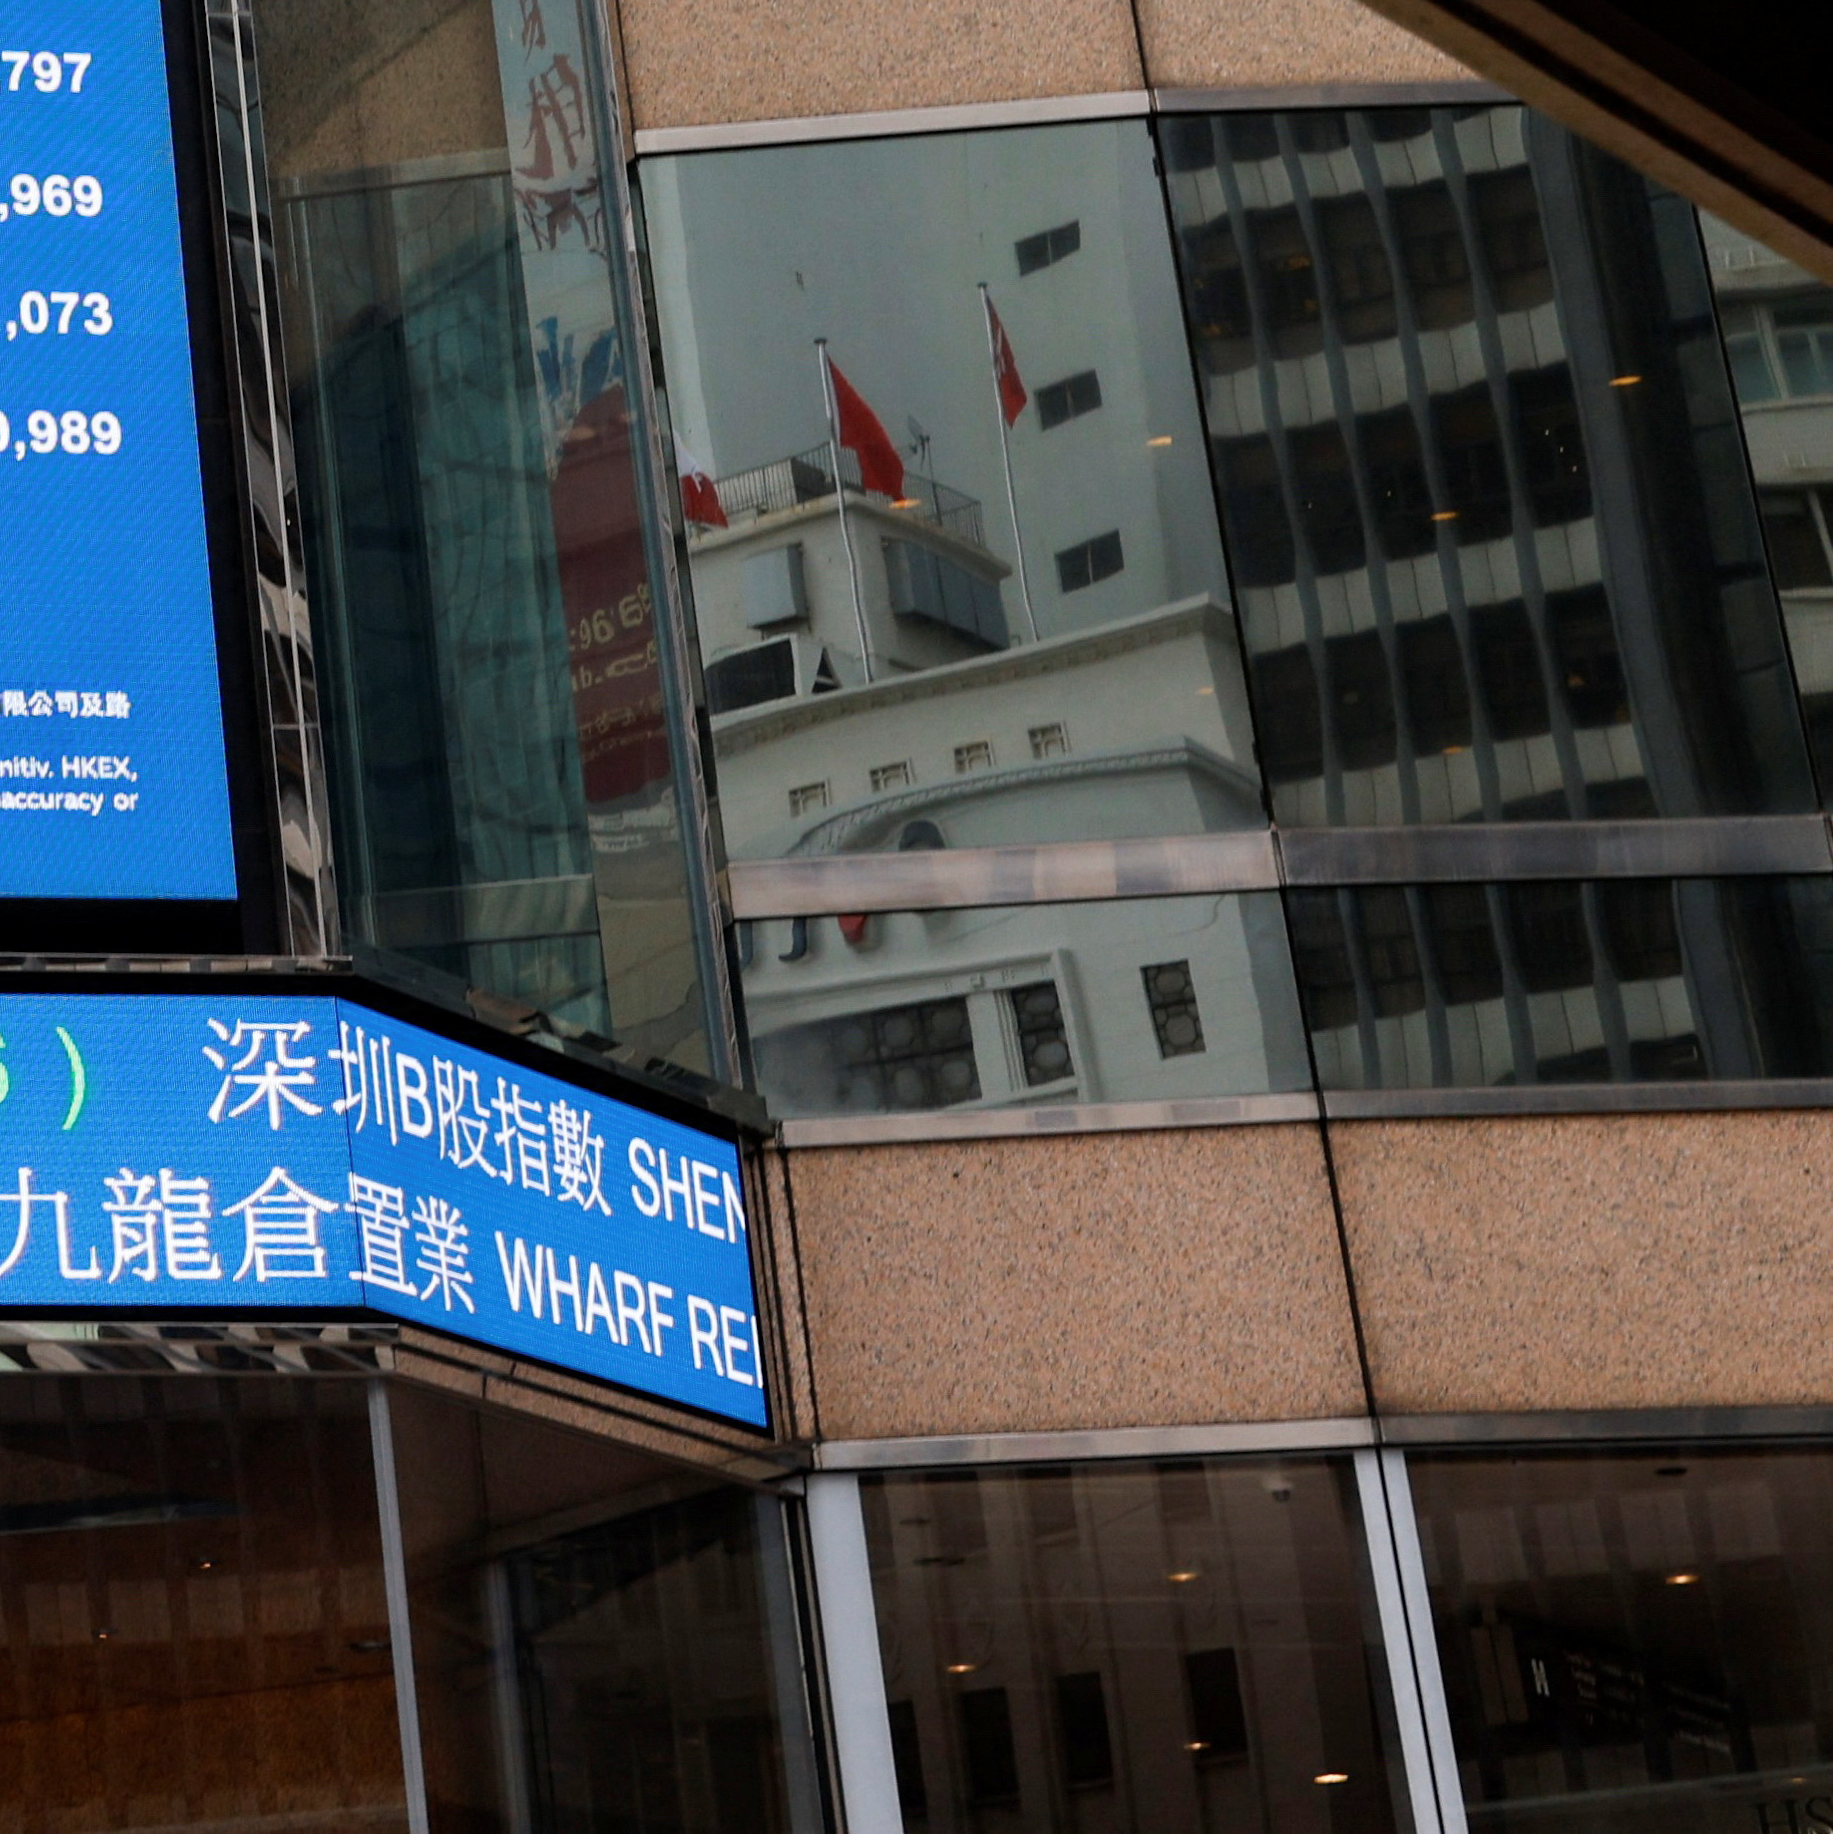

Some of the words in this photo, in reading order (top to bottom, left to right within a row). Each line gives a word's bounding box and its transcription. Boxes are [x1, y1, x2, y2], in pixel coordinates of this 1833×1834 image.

[62, 757, 137, 781] HKEX,
[114, 794, 138, 810] or
[197, 1019, 612, 1220] 深圳B股指數
[496, 1232, 674, 1356] WHARF
